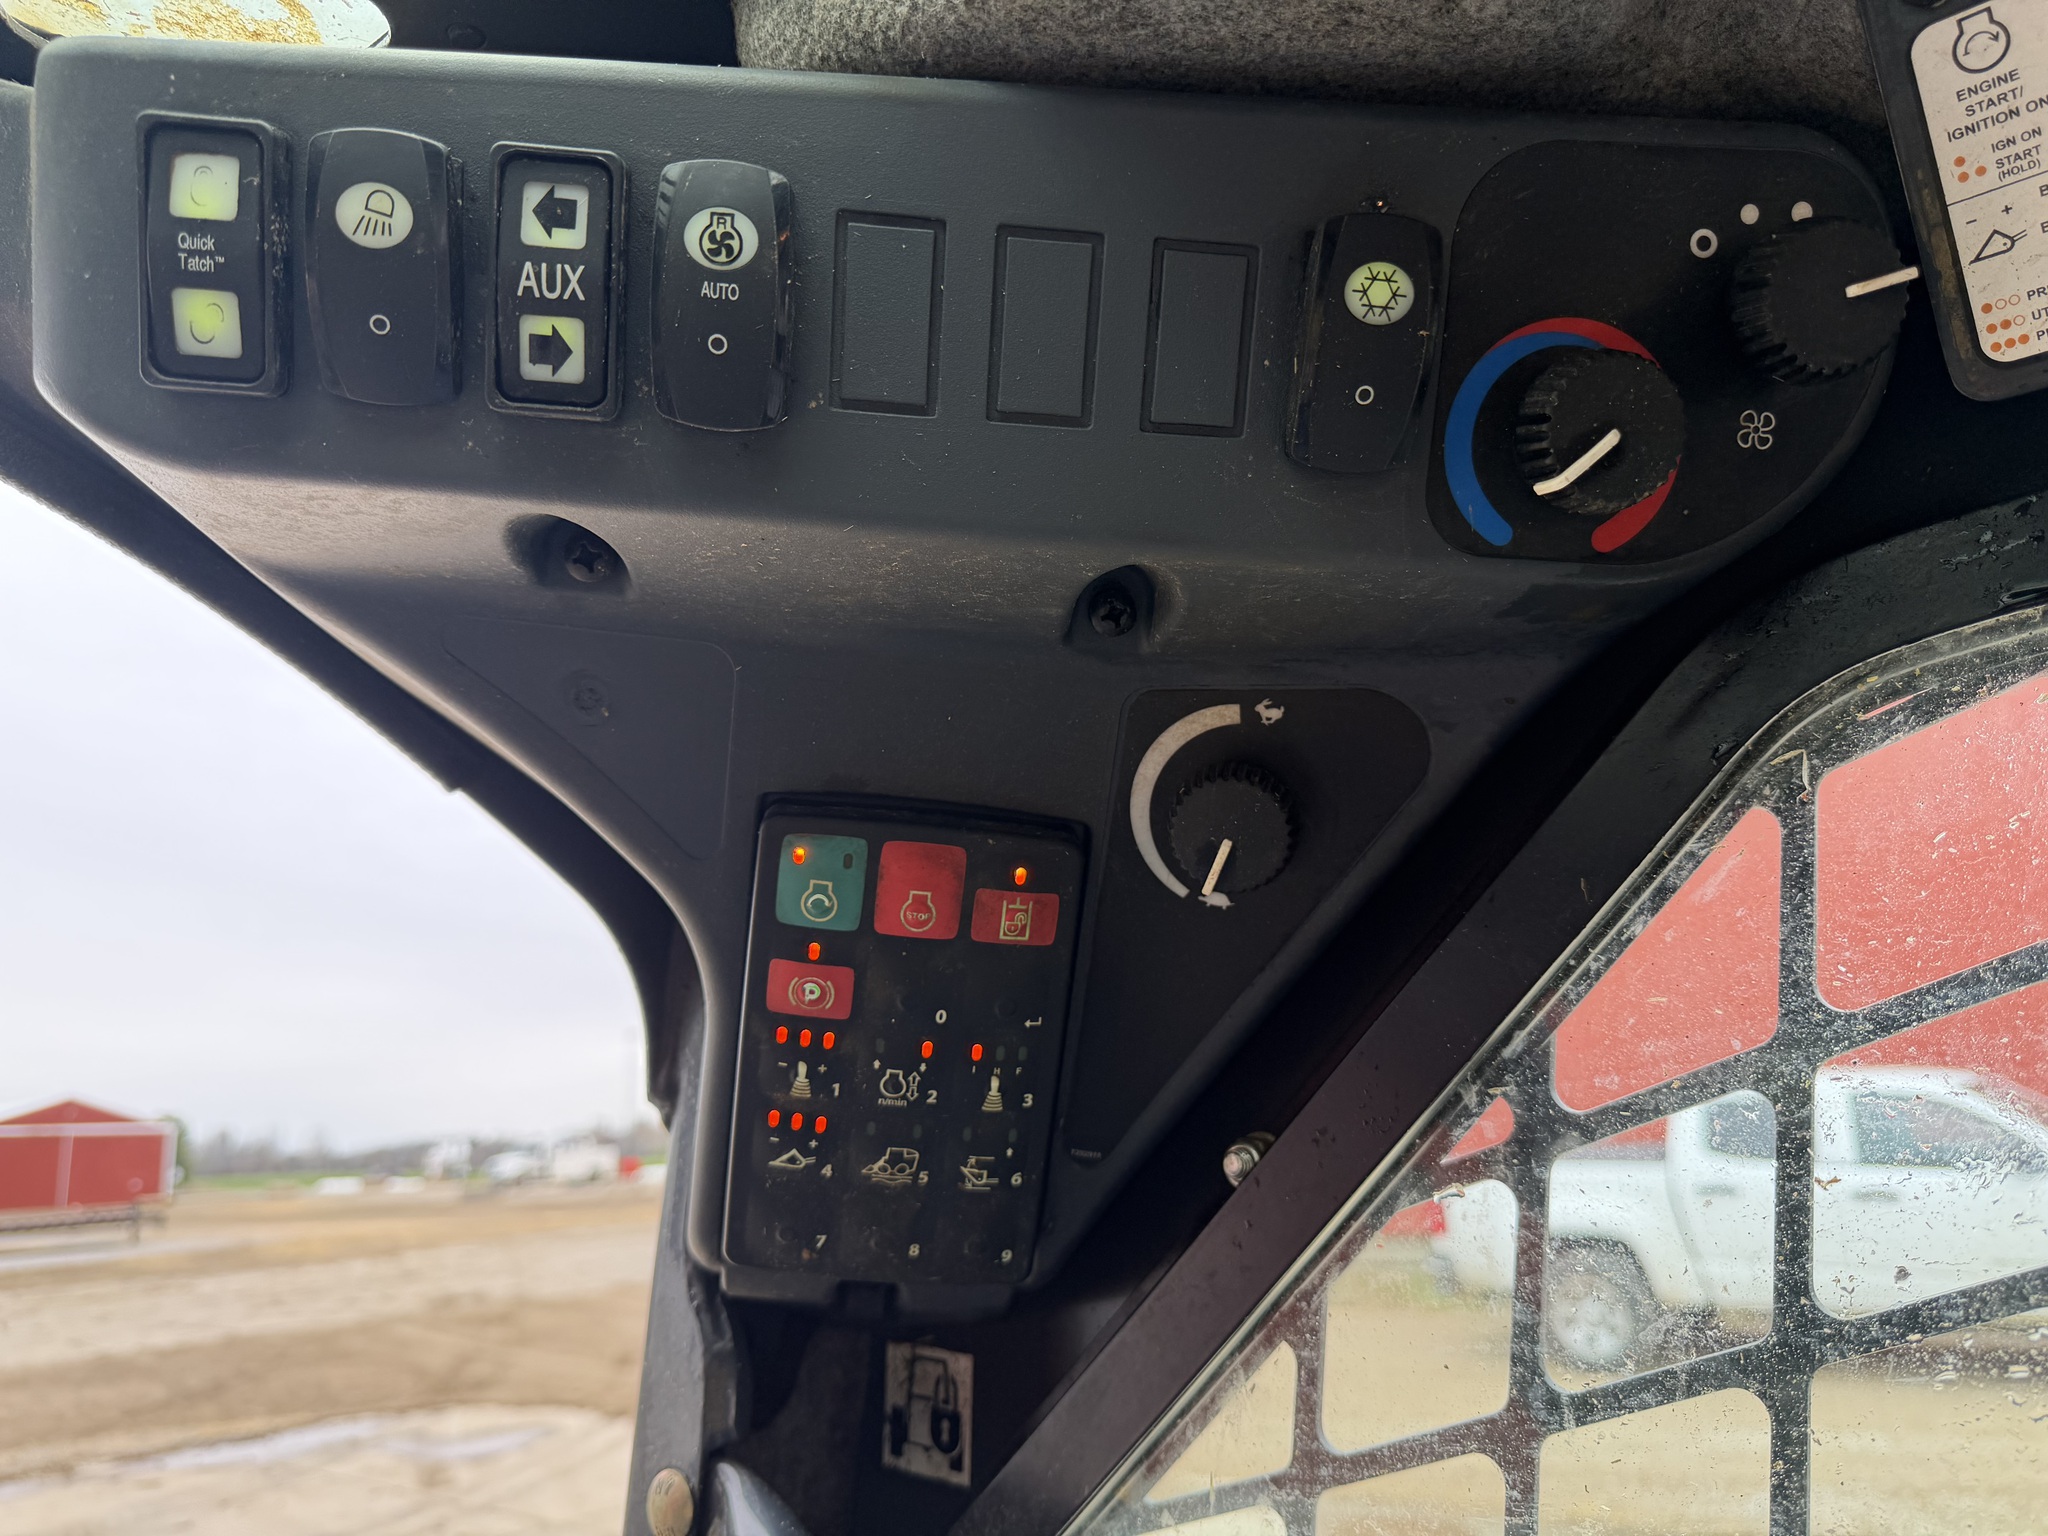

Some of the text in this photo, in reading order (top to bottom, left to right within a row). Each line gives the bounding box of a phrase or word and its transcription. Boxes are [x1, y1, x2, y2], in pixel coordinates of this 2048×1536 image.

[1955, 68, 2021, 102] ENGINE
[1964, 85, 2024, 117] START/
[1946, 106, 2021, 143] IGNITION
[1991, 126, 2042, 153] IGN ON
[1995, 144, 2042, 169] START
[1998, 158, 2042, 182] (HOLD)
[177, 232, 216, 251] Quick
[516, 261, 586, 301] AUX
[700, 281, 740, 301] AUTO
[2026, 286, 2048, 301] PR
[905, 911, 931, 921] STOP
[803, 982, 821, 1004] P
[1015, 1066, 1022, 1076] F
[832, 1082, 840, 1097] 1
[925, 1089, 938, 1105] 2
[877, 1097, 908, 1108] n/min
[1021, 1093, 1034, 1108] 3
[820, 1163, 833, 1178] 4
[917, 1170, 929, 1184] 5
[1010, 1171, 1023, 1186] 6
[815, 1234, 827, 1250] 7
[908, 1243, 920, 1258] 8
[1000, 1249, 1013, 1264] 9
